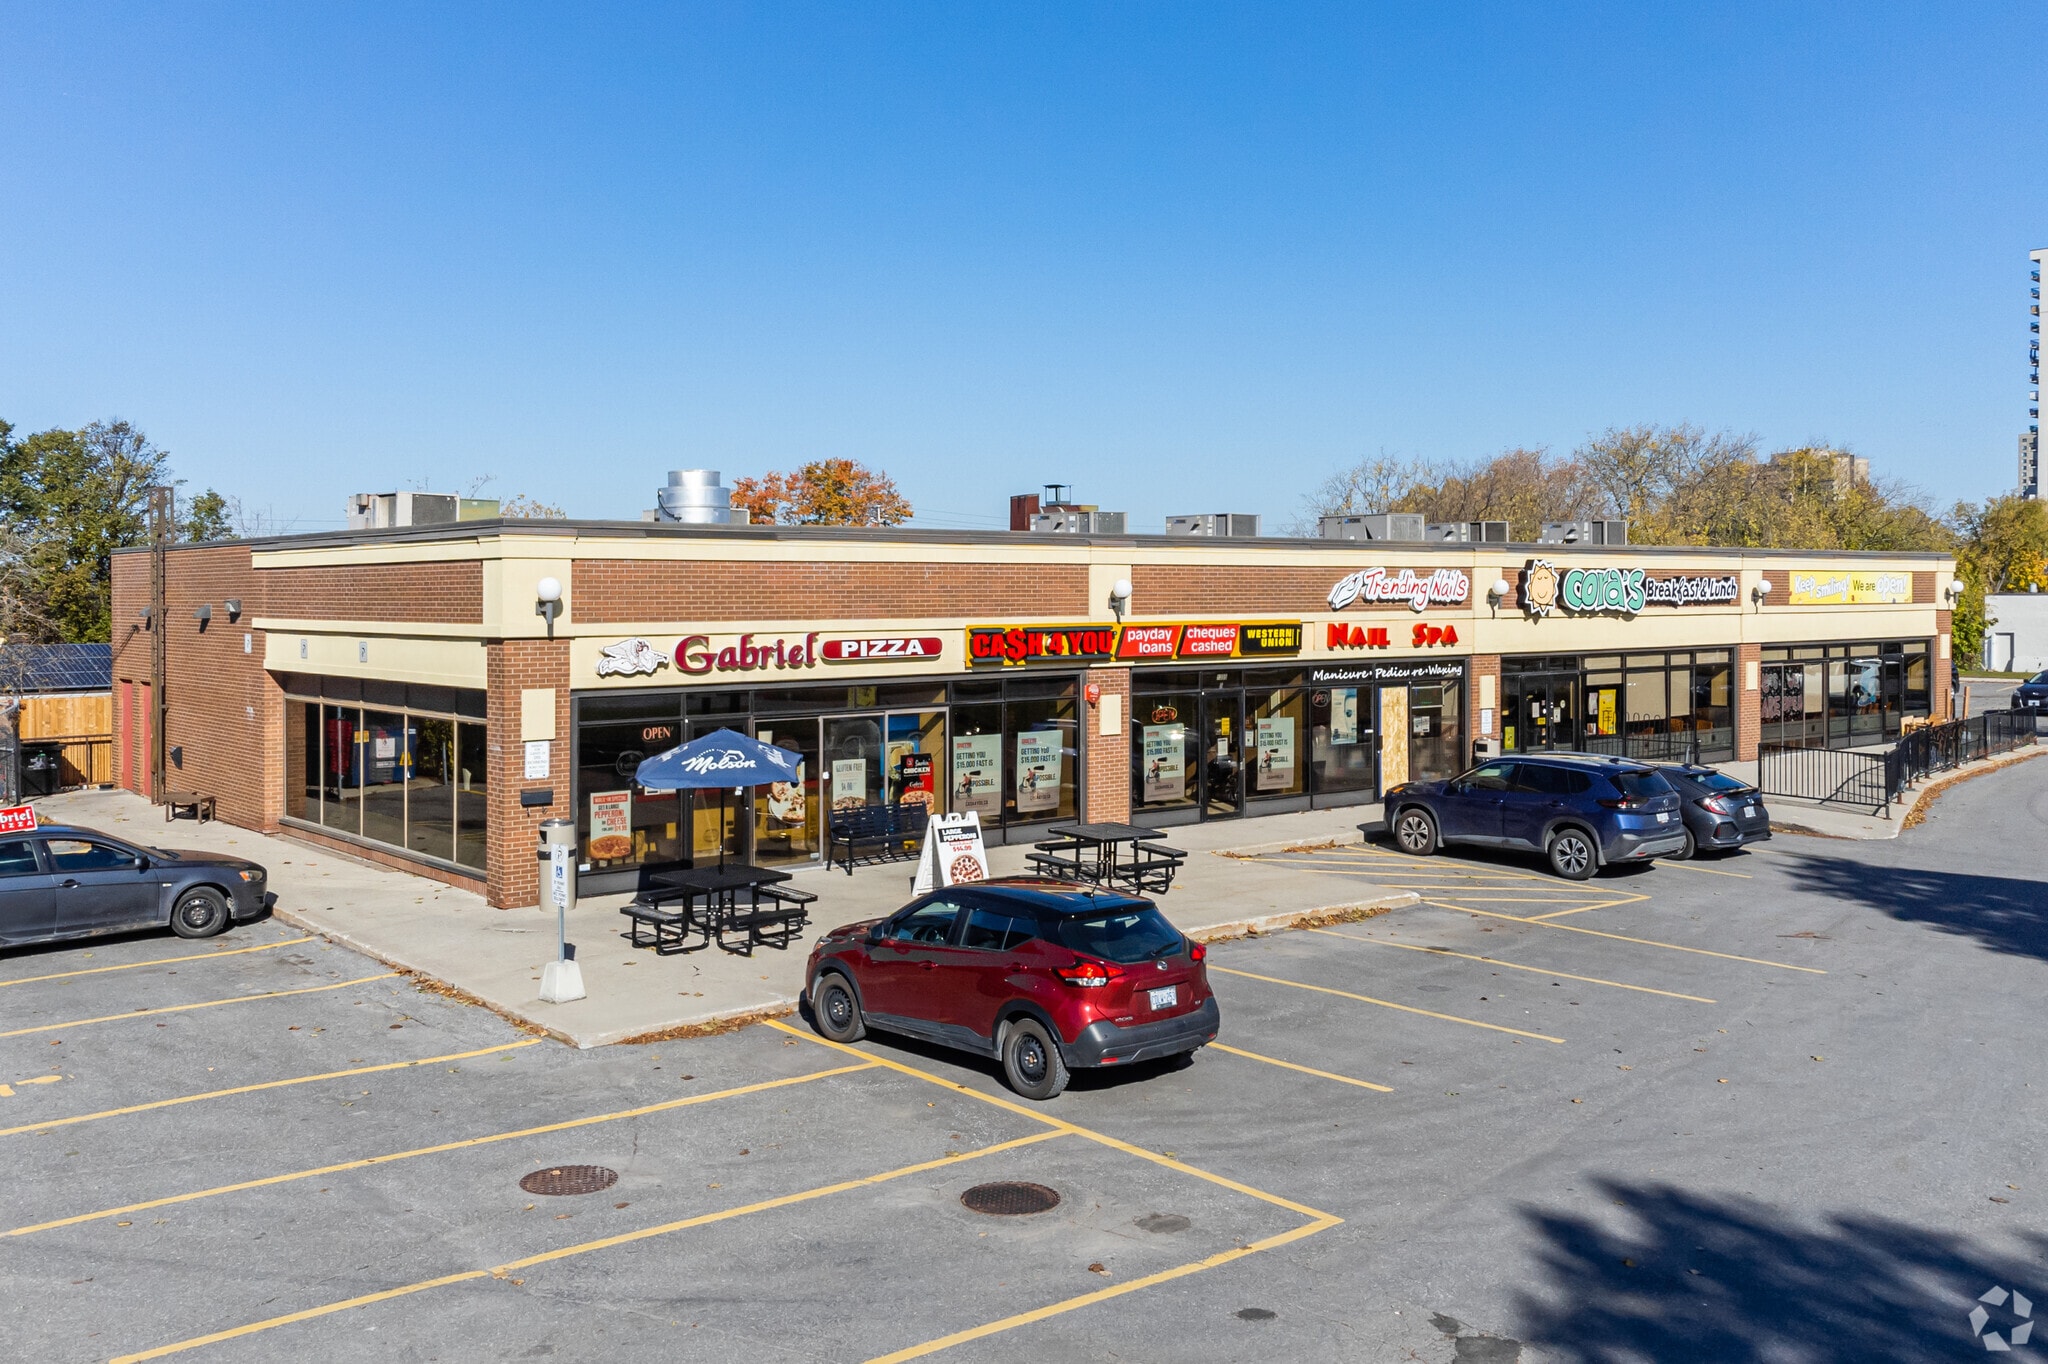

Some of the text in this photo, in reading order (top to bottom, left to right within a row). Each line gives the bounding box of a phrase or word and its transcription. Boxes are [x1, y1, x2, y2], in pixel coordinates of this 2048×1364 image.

[1365, 570, 1467, 607] Trending Nails
[1648, 576, 1737, 602] Breakfast & Lunch
[1794, 575, 1815, 598] Keep
[1852, 580, 1864, 591] We
[1865, 582, 1876, 591] are
[1876, 574, 1908, 602] open!
[1127, 628, 1172, 642] payday
[1187, 627, 1236, 640] cheques
[1247, 629, 1292, 639] WESTERN
[841, 639, 925, 658] PIZZA
[972, 628, 1114, 661] CA$H 4 YOU
[1139, 641, 1172, 653] loans
[1191, 640, 1232, 652] cashed
[1260, 638, 1291, 647] UNION
[674, 632, 819, 672] Gabriel
[1313, 668, 1368, 681] Manicure
[1428, 664, 1463, 675] Waxing
[643, 727, 671, 740] OPEN
[682, 755, 756, 775] Molson
